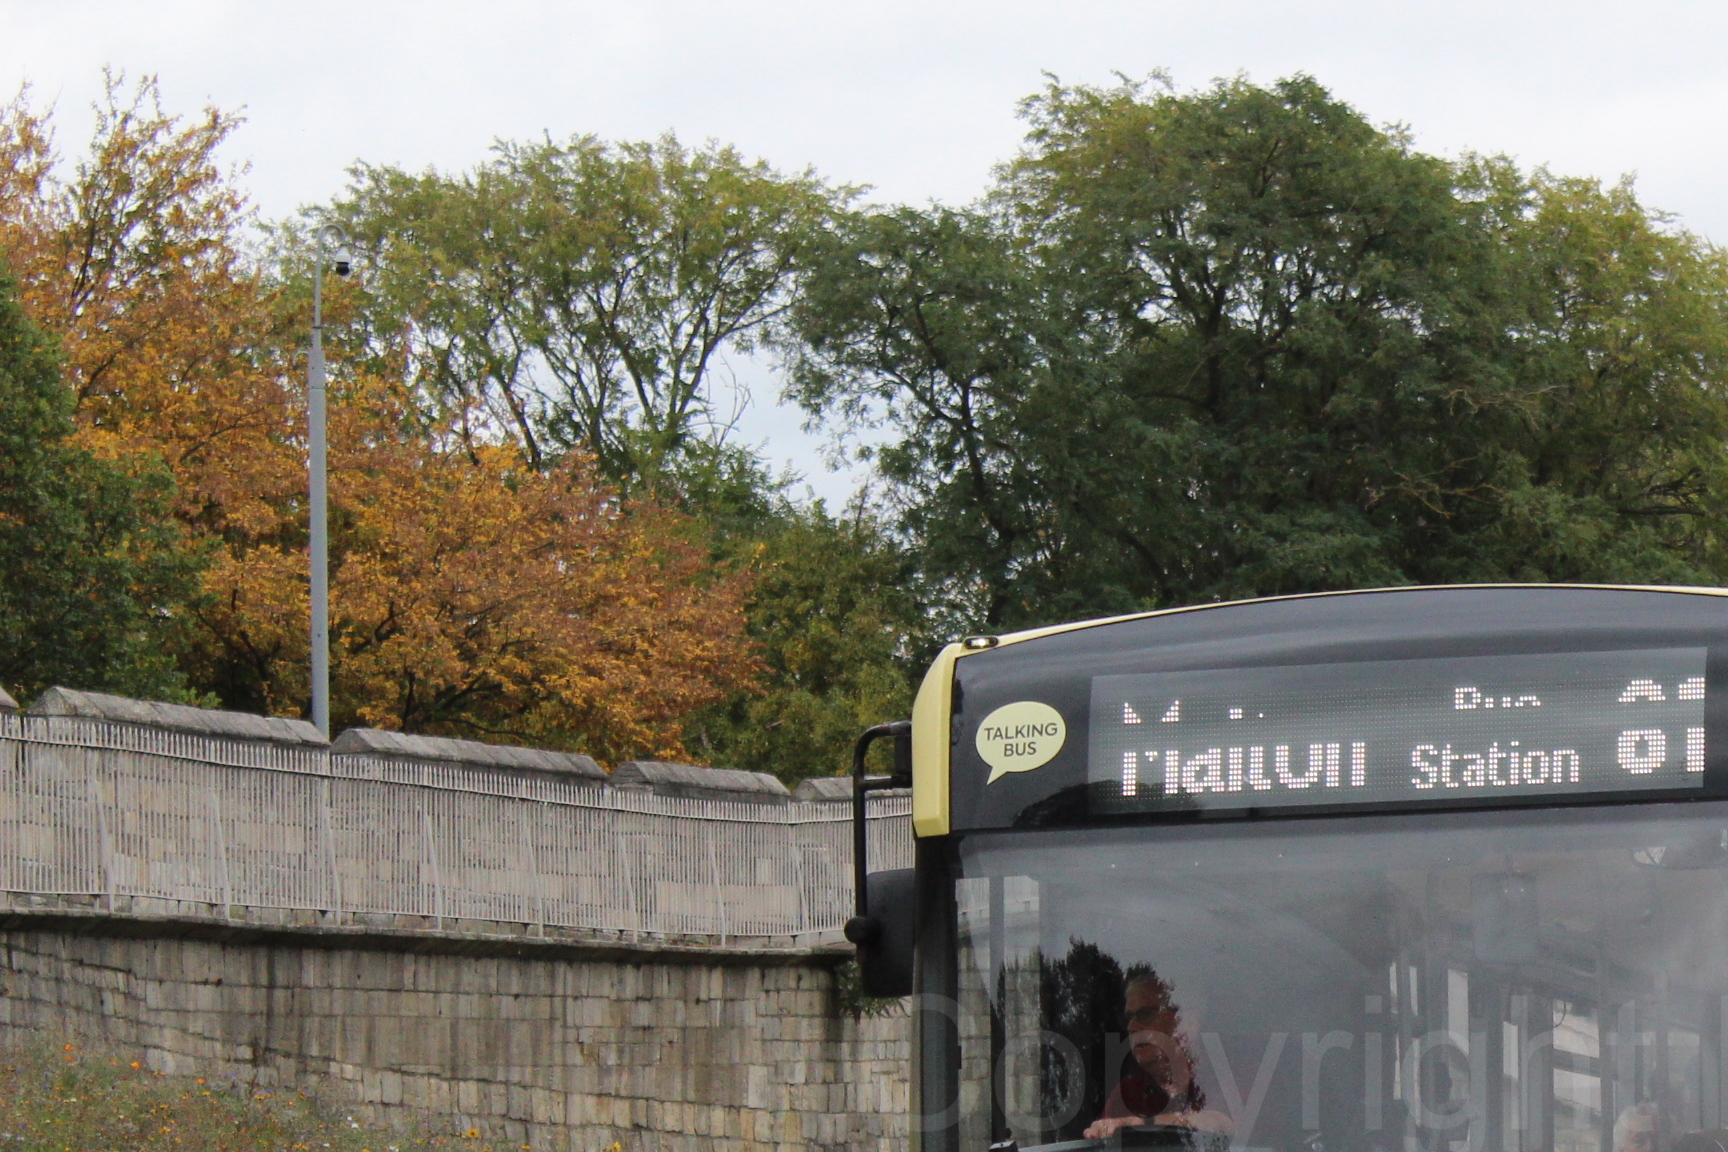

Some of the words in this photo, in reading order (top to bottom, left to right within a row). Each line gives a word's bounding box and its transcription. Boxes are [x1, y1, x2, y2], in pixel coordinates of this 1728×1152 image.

[983, 722, 1059, 741] TALKING
[1003, 741, 1037, 757] BUS
[1411, 741, 1580, 790] Station
